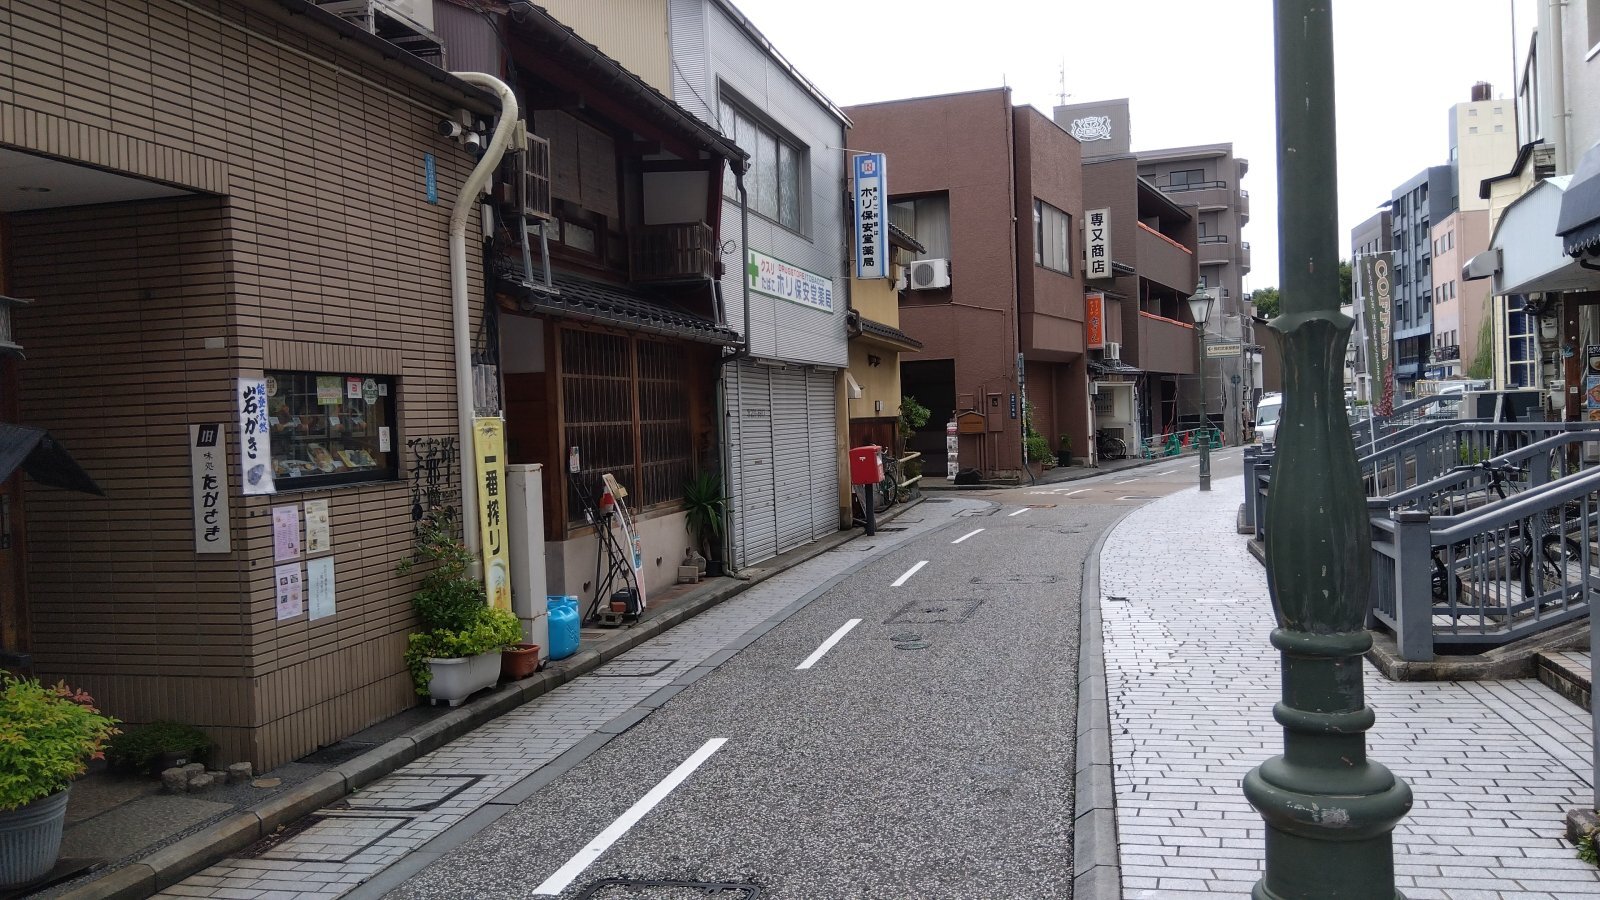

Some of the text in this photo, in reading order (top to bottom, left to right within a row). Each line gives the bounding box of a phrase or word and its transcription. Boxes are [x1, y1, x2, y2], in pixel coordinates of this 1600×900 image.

[861, 188, 874, 267] ホリ保安堂薬局
[1091, 213, 1105, 274] 専又商店
[761, 260, 775, 275] クスリ
[761, 276, 776, 292] たばこ
[777, 273, 832, 309] ホリ保安堂薬局
[242, 385, 258, 459] 岩がき
[256, 383, 268, 433] 能登天然
[202, 430, 214, 442] 旧
[202, 451, 220, 542] 味処 たかさき
[484, 455, 501, 555] 一番搾り
